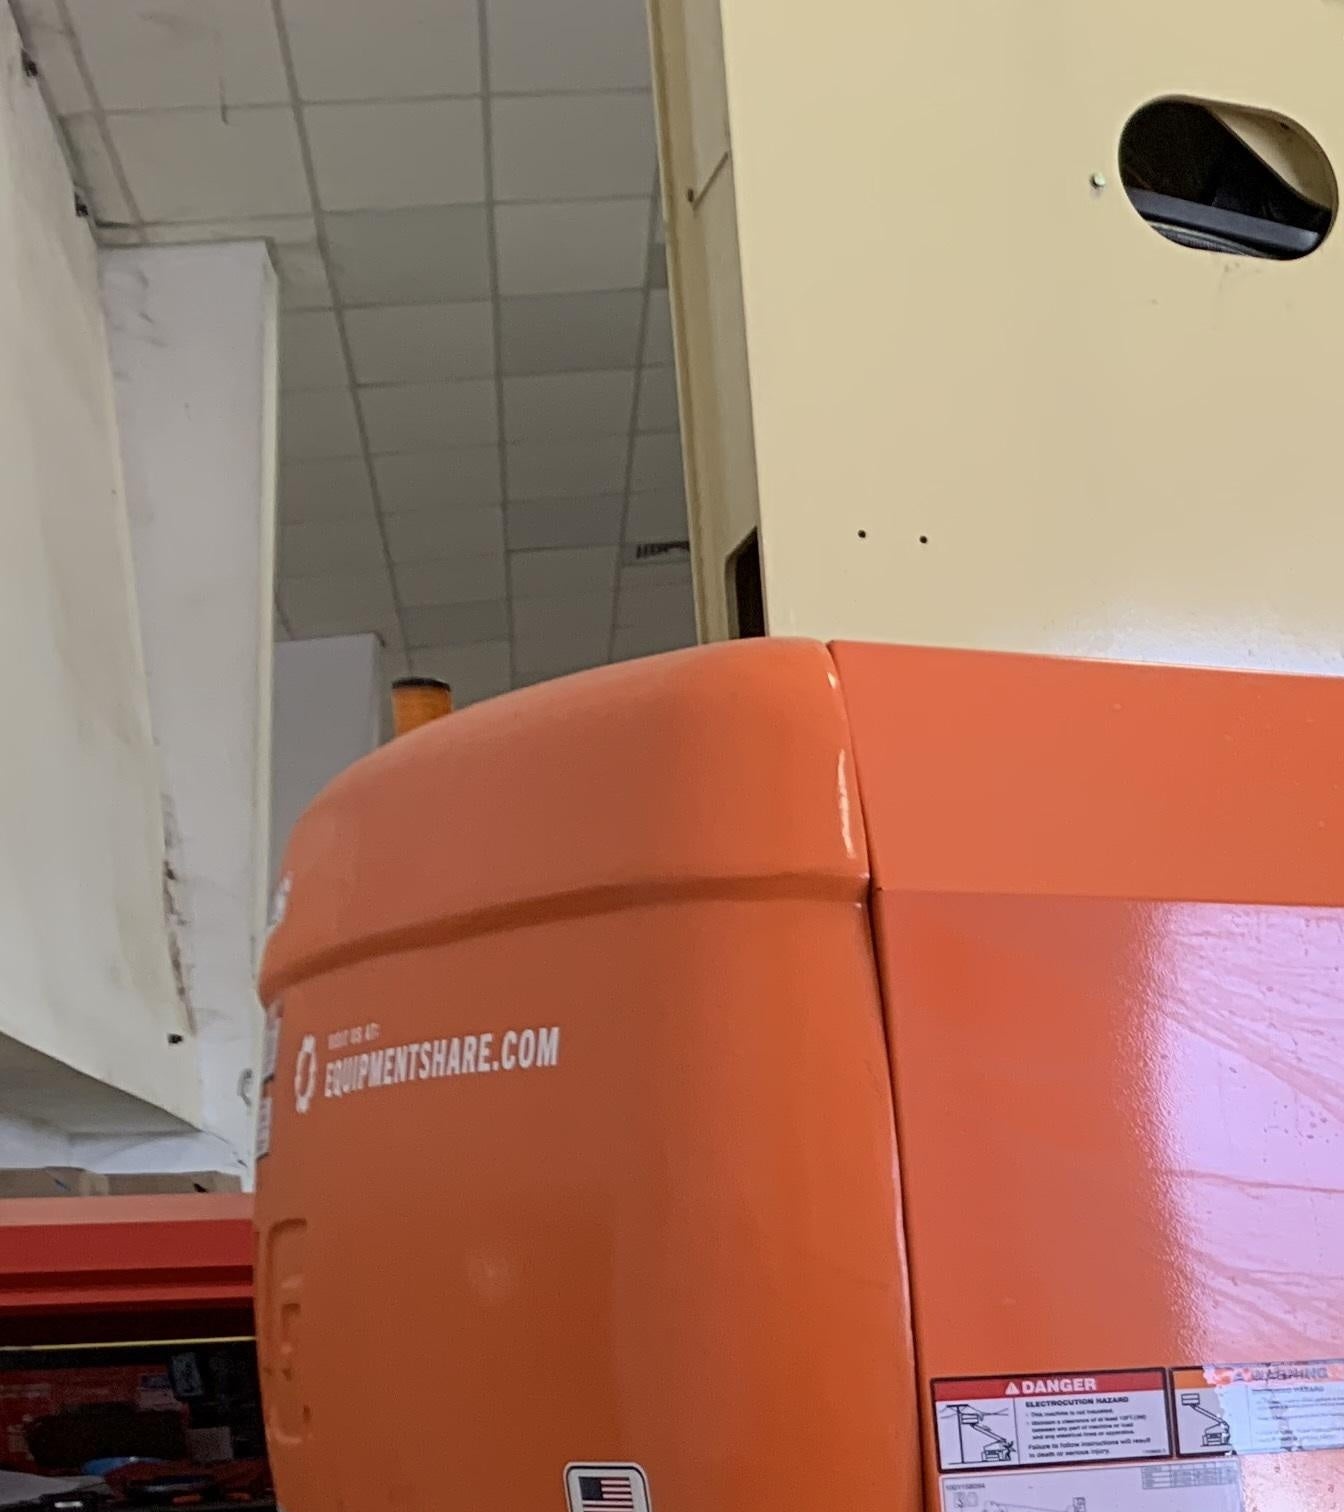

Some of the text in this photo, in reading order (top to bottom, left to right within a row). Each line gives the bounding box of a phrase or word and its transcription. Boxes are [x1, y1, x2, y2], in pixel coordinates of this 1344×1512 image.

[324, 1026, 560, 1098] EQUIPMENTSHARE.COM
[1022, 1378, 1097, 1394] DANGER
[1025, 1396, 1129, 1408] ELECTROCUTION HAZARD
